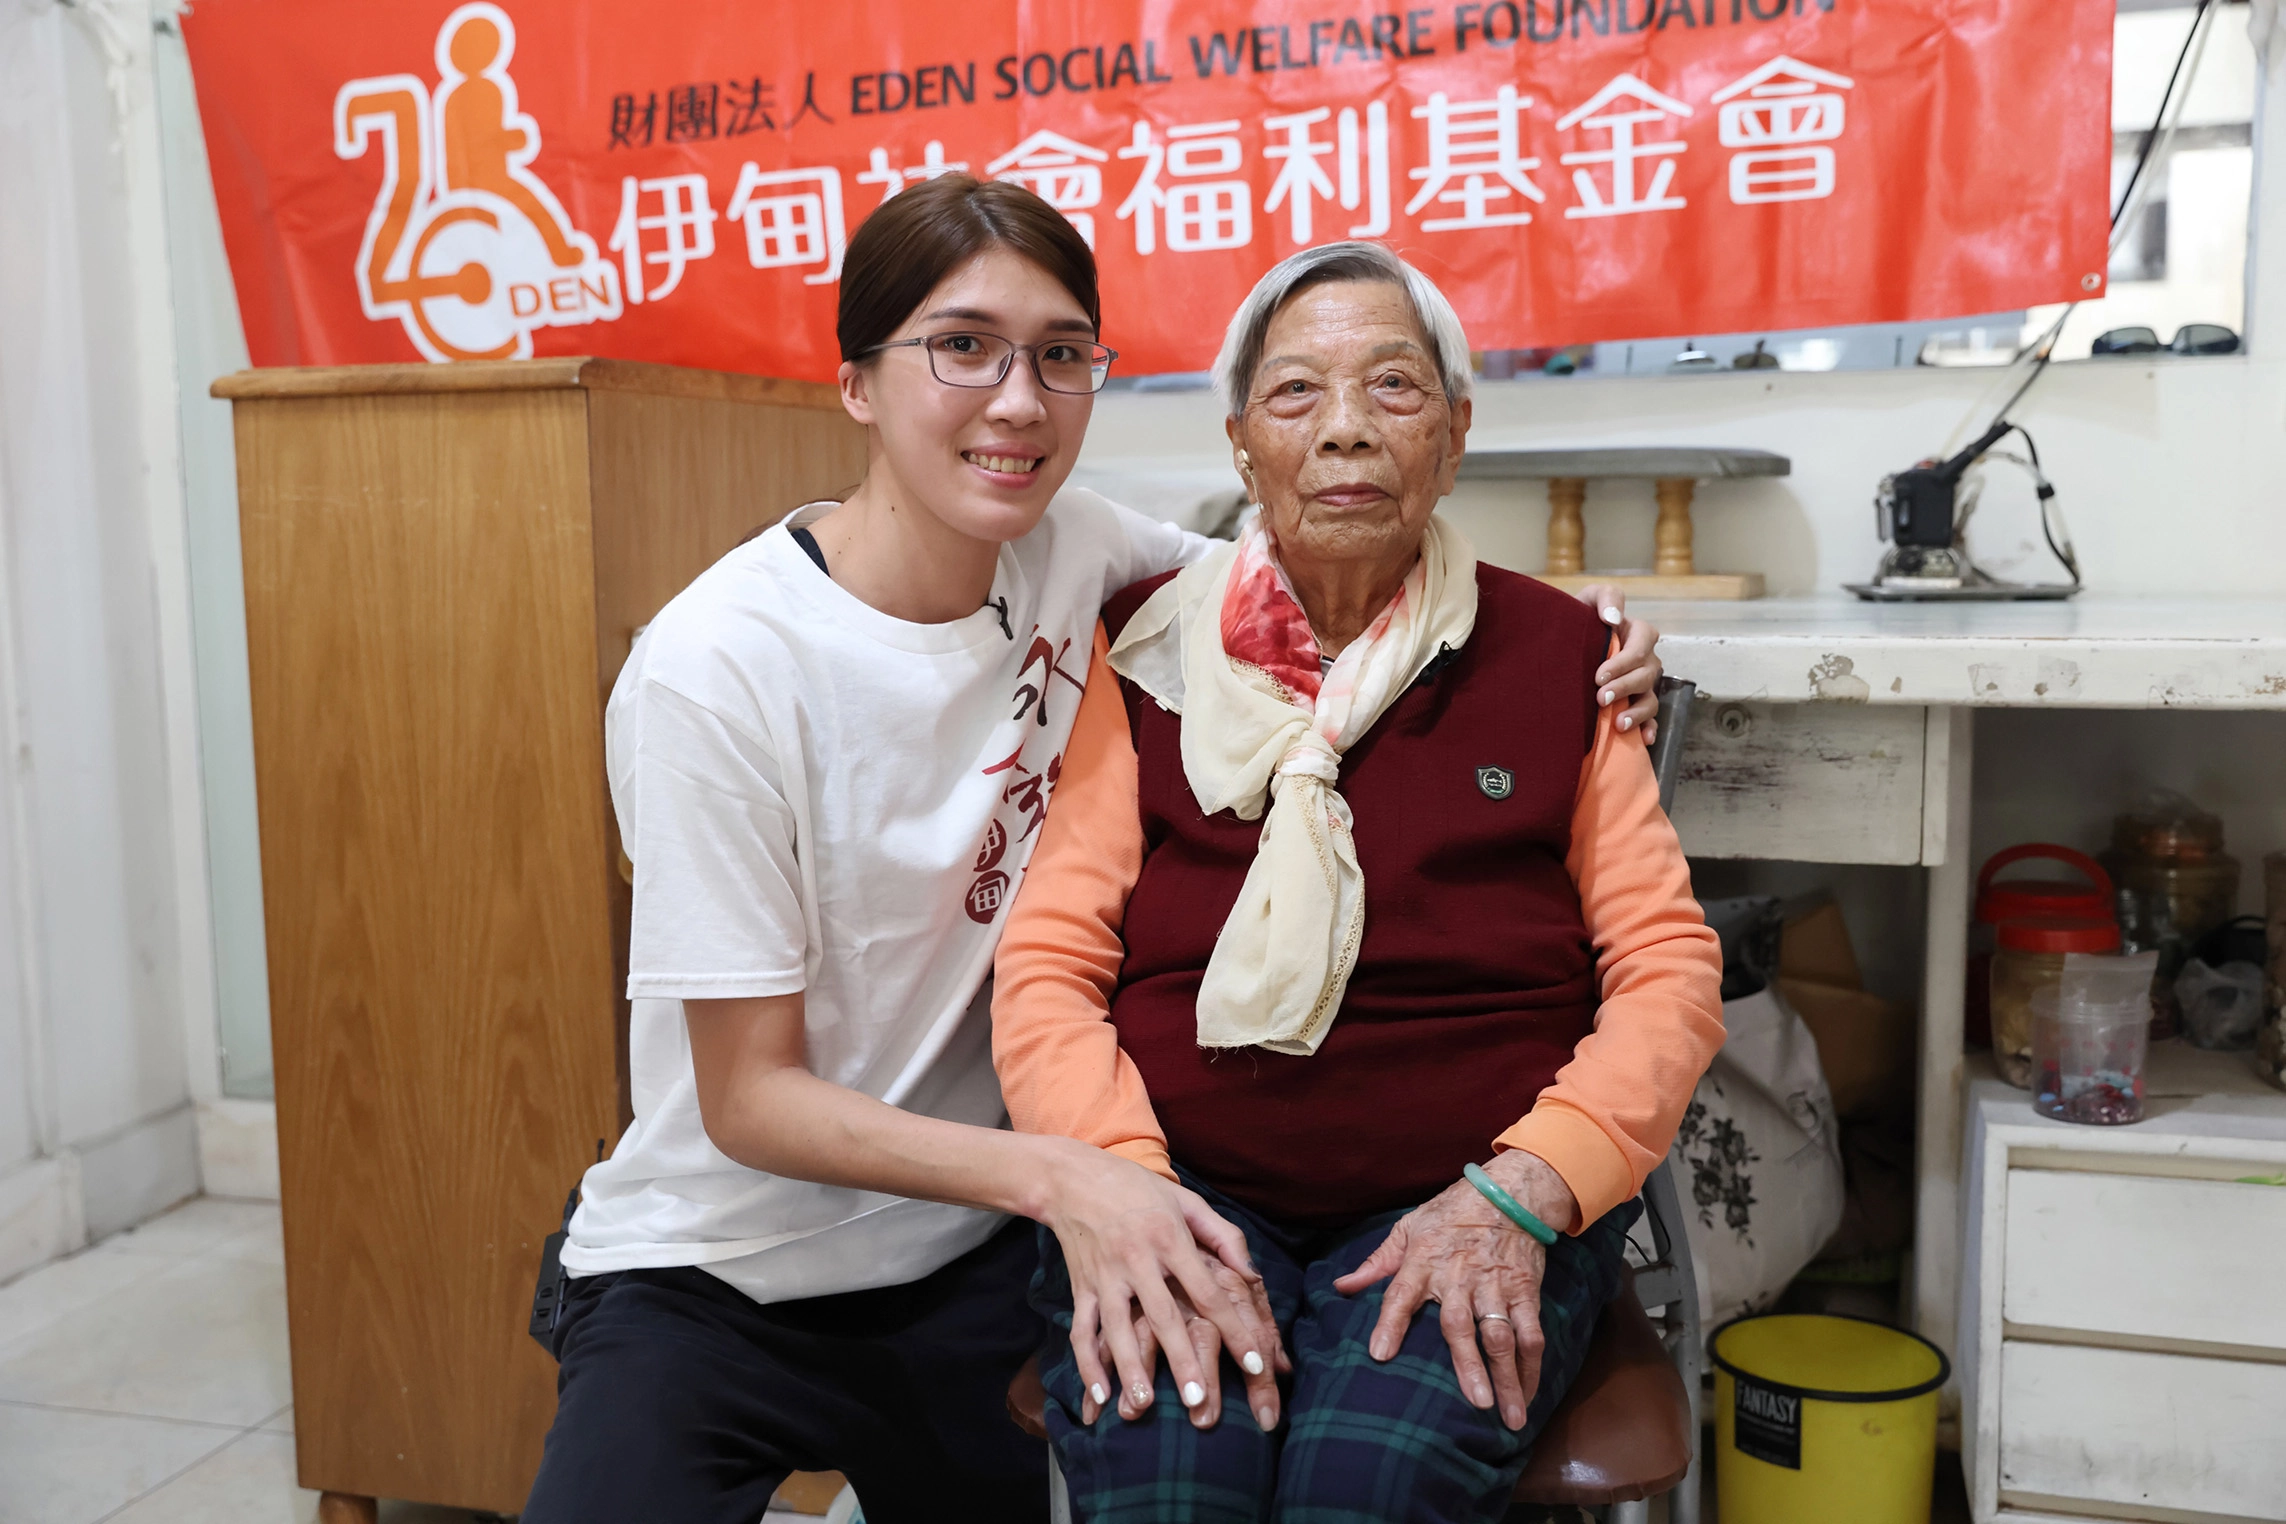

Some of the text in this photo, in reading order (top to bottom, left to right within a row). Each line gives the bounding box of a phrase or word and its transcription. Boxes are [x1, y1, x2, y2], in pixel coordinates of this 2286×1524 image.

[607, 71, 836, 152] 財團法人
[851, 61, 976, 115] EDEN
[994, 39, 1173, 101] SOCIAL
[1187, 9, 1437, 80] WELFARE
[1735, 1379, 1798, 1425] FANTASY
